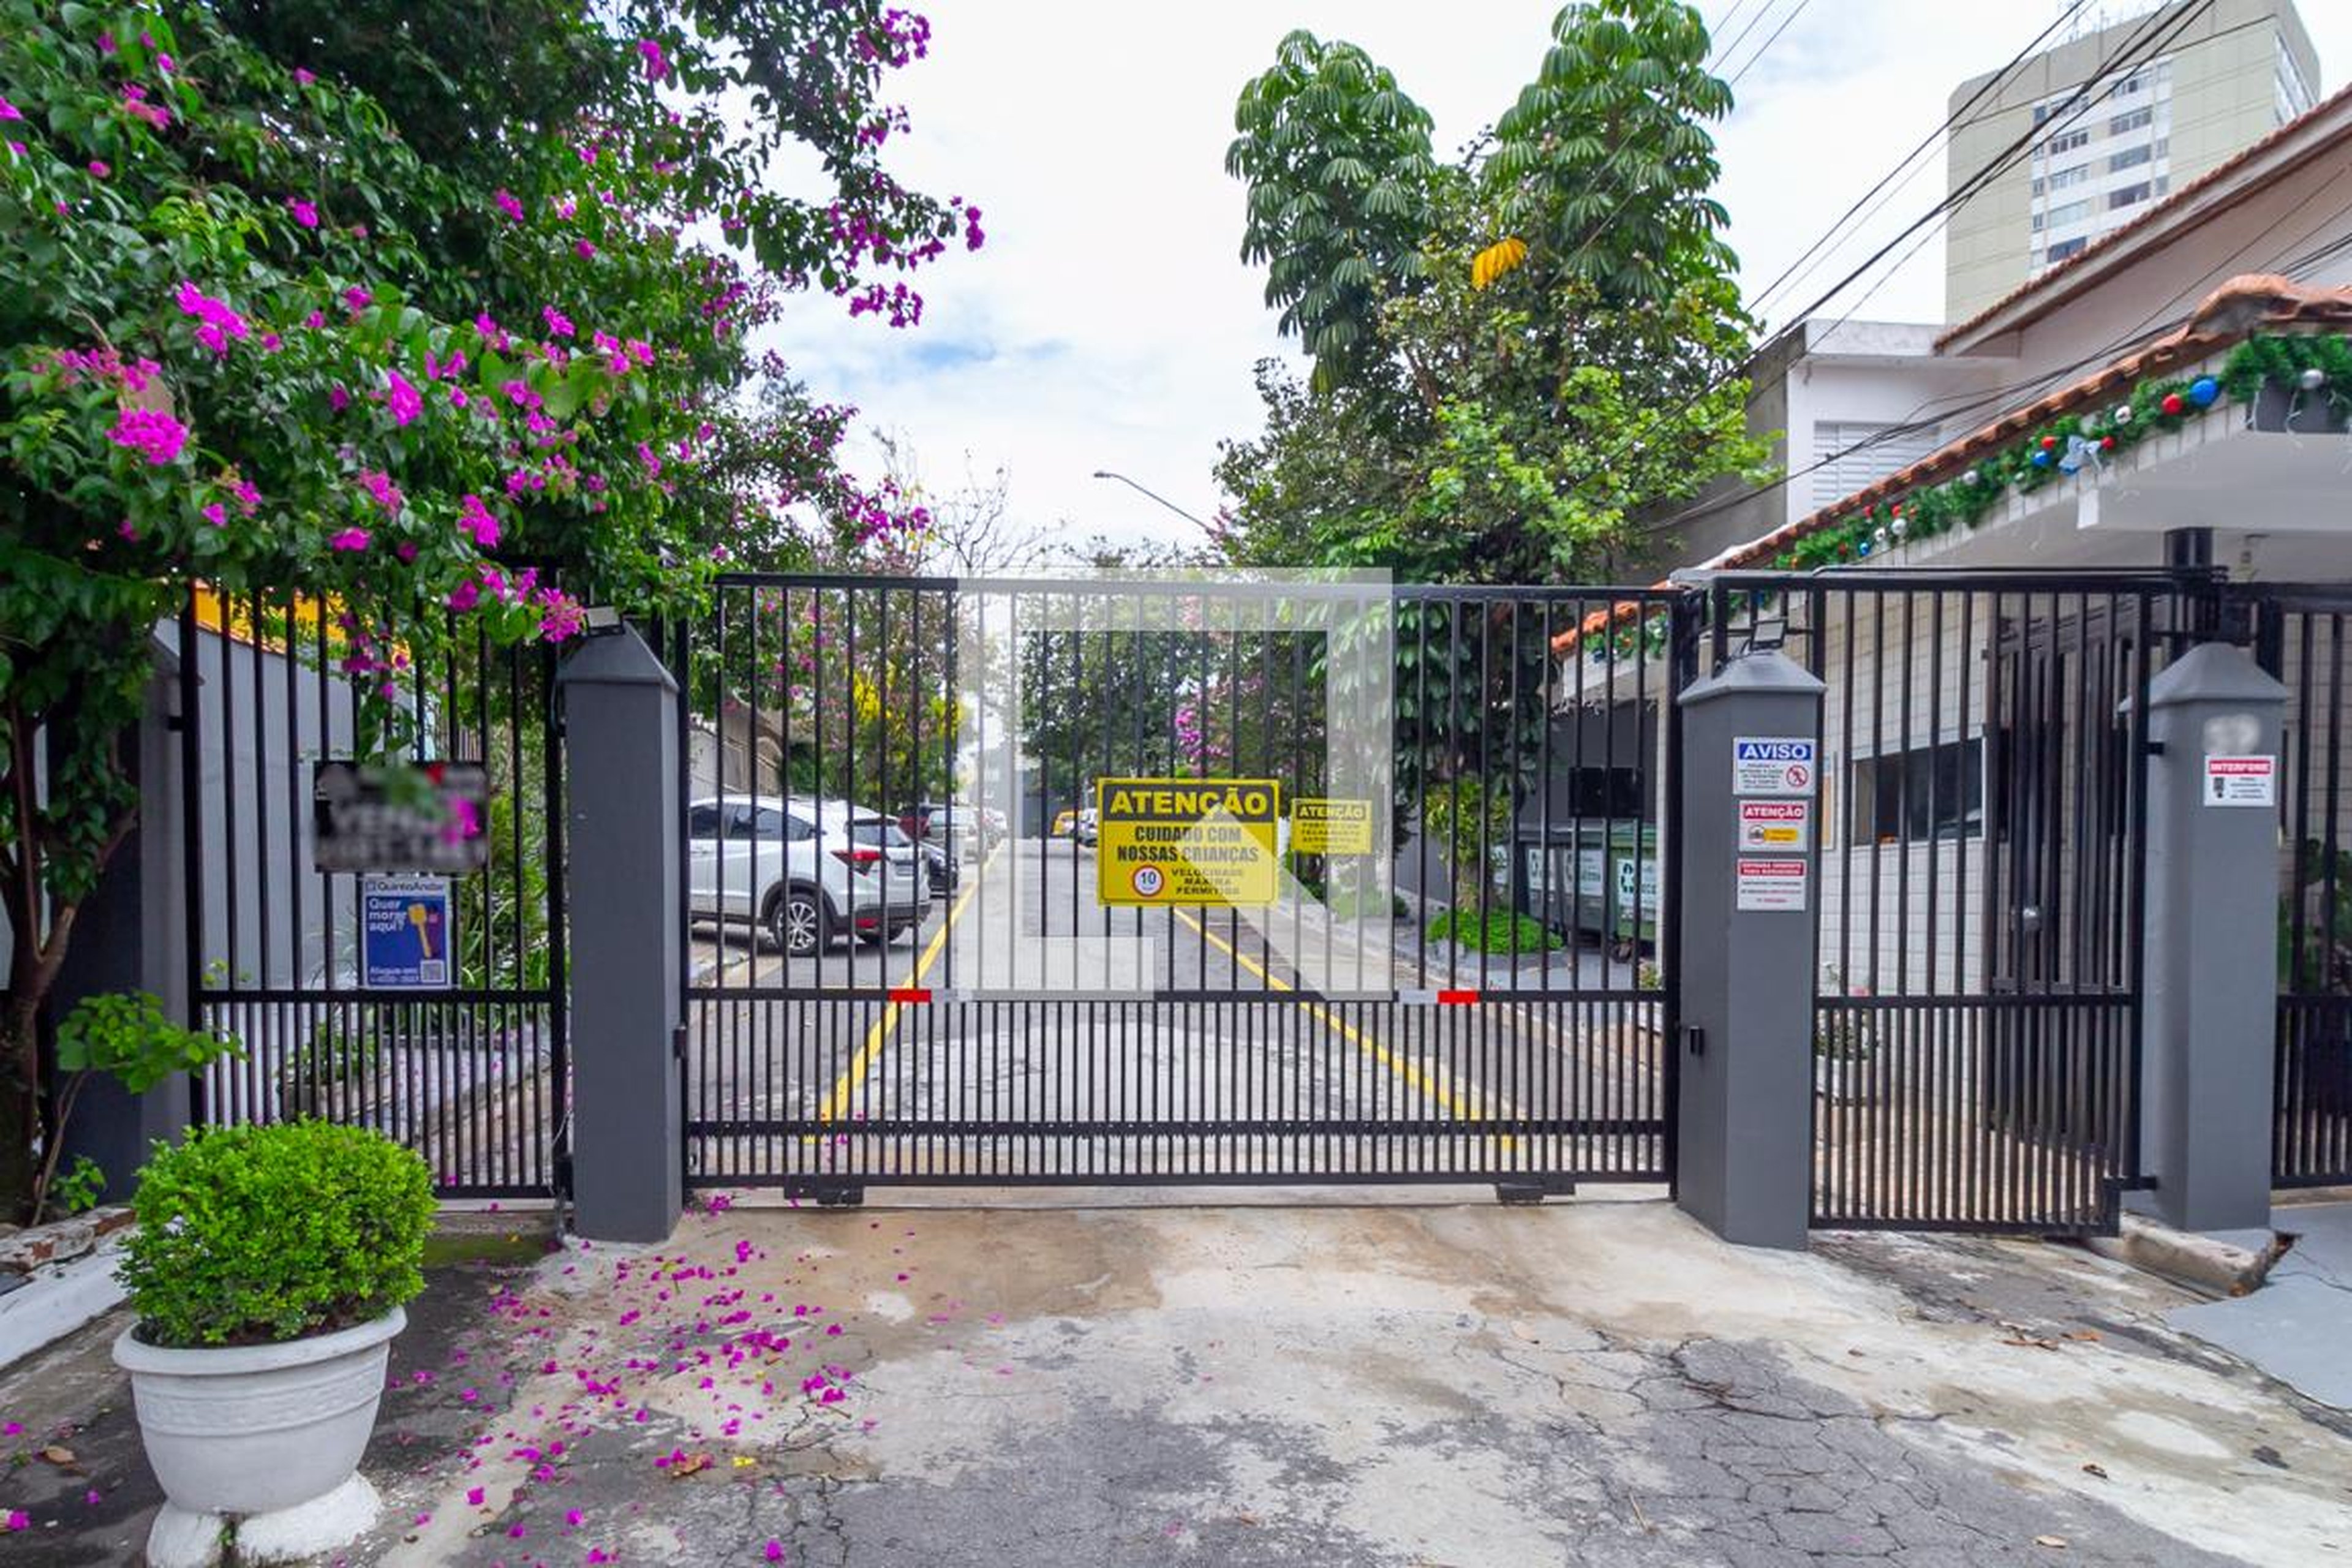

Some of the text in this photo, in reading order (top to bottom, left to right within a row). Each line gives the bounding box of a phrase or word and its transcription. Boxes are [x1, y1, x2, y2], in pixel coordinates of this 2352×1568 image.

[1744, 744, 1807, 760] AVISO
[1110, 786, 1268, 818] ATENÇÃO
[1299, 804, 1364, 819] ATENÇÃO
[1745, 805, 1803, 818] ATENÇÃO
[1134, 826, 1242, 843] CUIDADO COM
[1118, 845, 1259, 865] NOSSAS CRIANÇAS
[1141, 872, 1156, 884] 10
[369, 899, 401, 909] Quer
[369, 911, 407, 920] morar
[369, 921, 405, 933] aqui?
